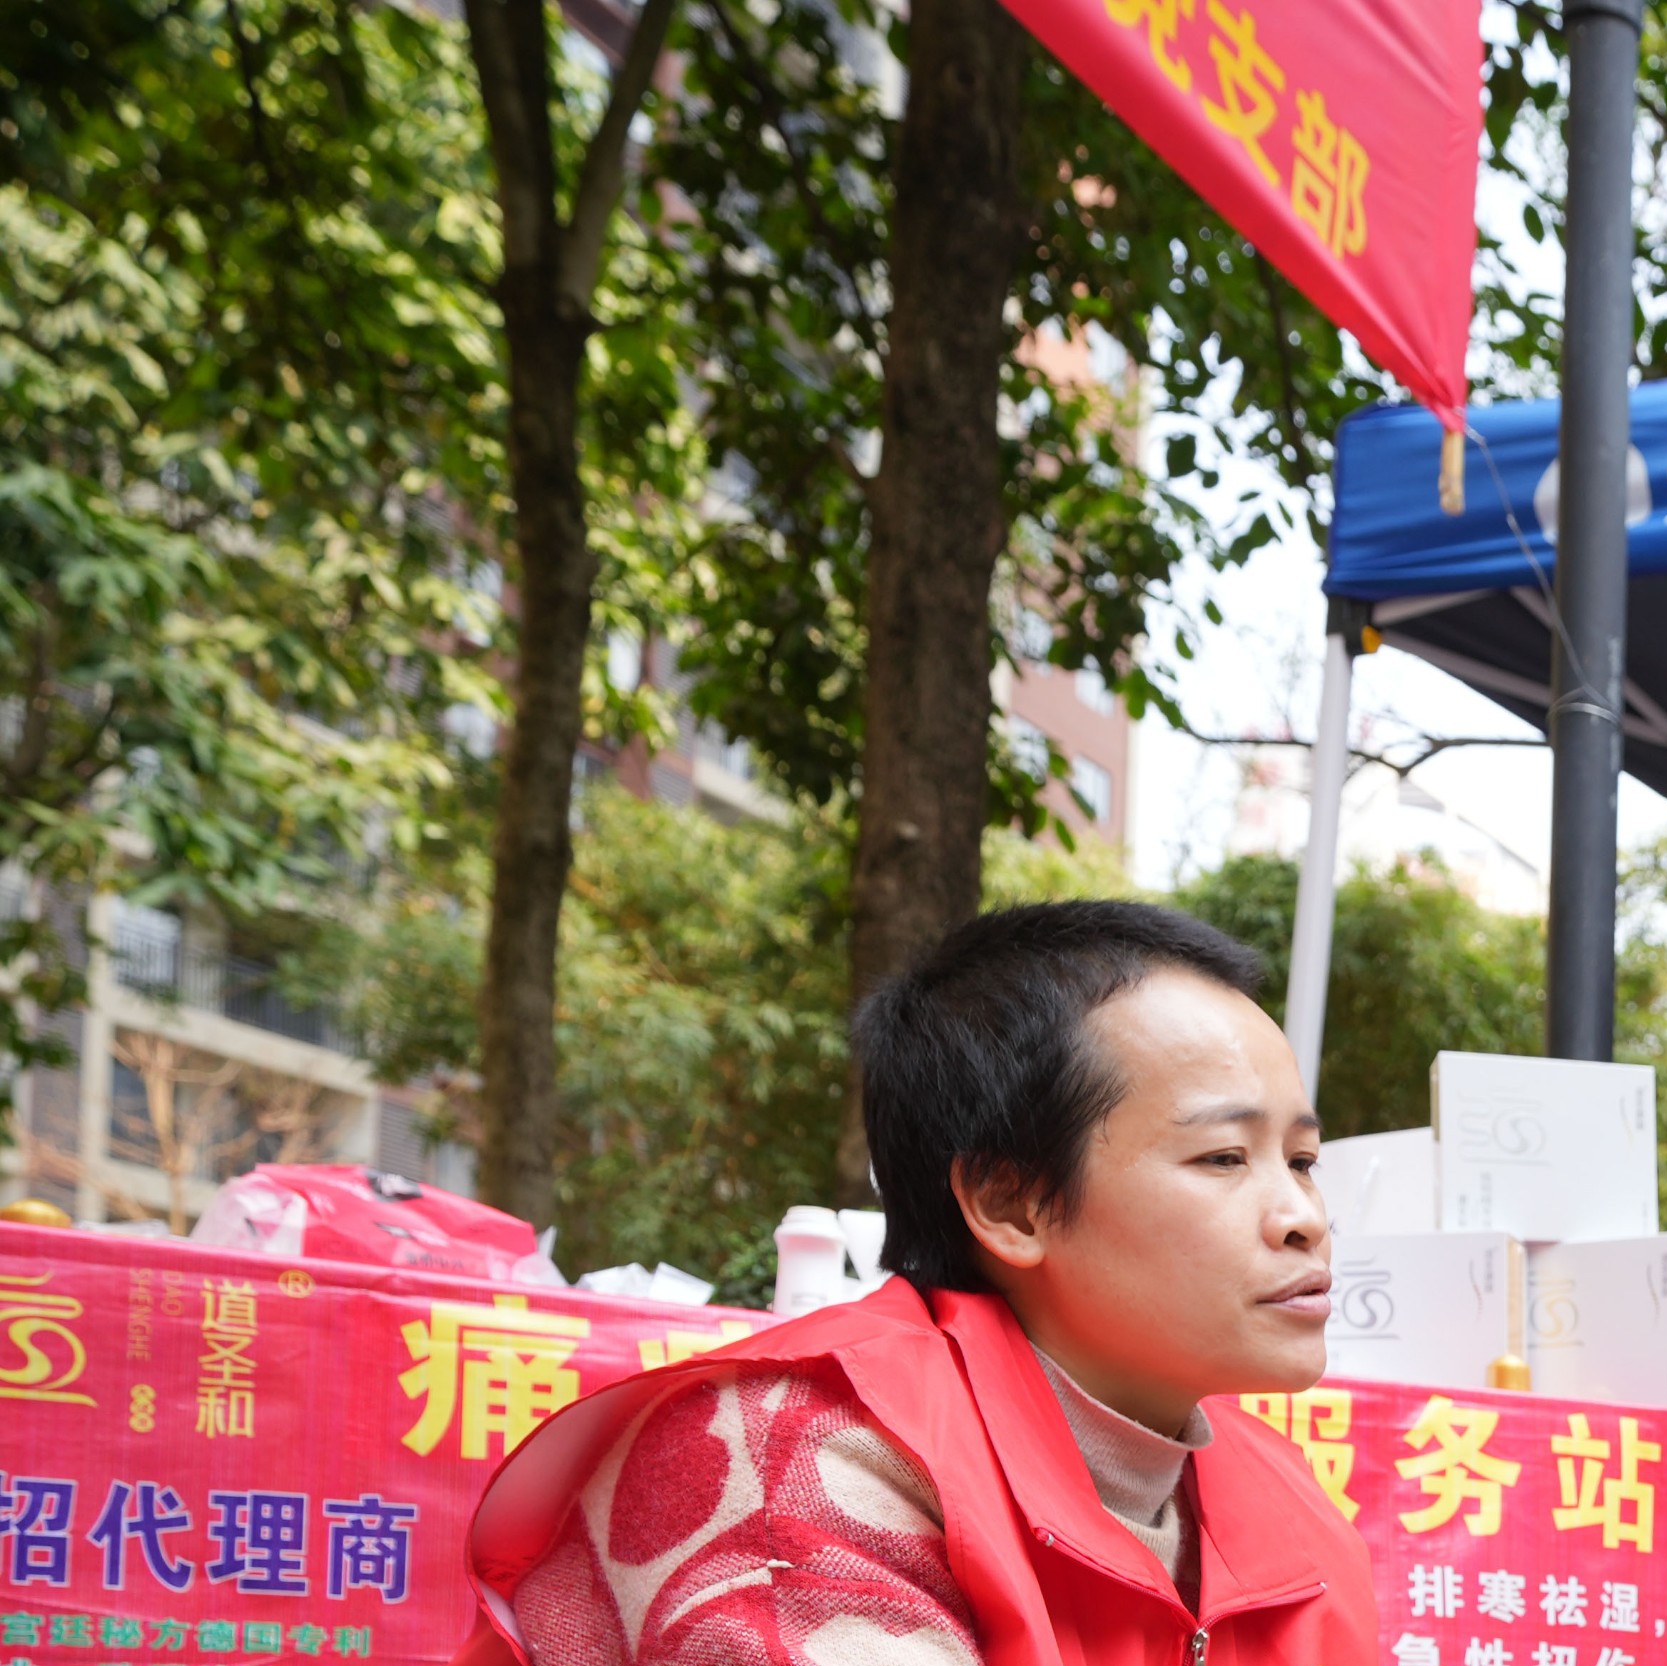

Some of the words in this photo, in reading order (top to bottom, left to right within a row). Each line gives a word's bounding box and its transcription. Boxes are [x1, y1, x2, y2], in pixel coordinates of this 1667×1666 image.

[195, 1278, 260, 1439] 道圣和
[0, 1470, 420, 1604] 招代理商
[1239, 1387, 1662, 1553] 服务站
[0, 1611, 372, 1658] 宫廷秘方德国专利
[1408, 1563, 1666, 1638] 排寒祛湿，
